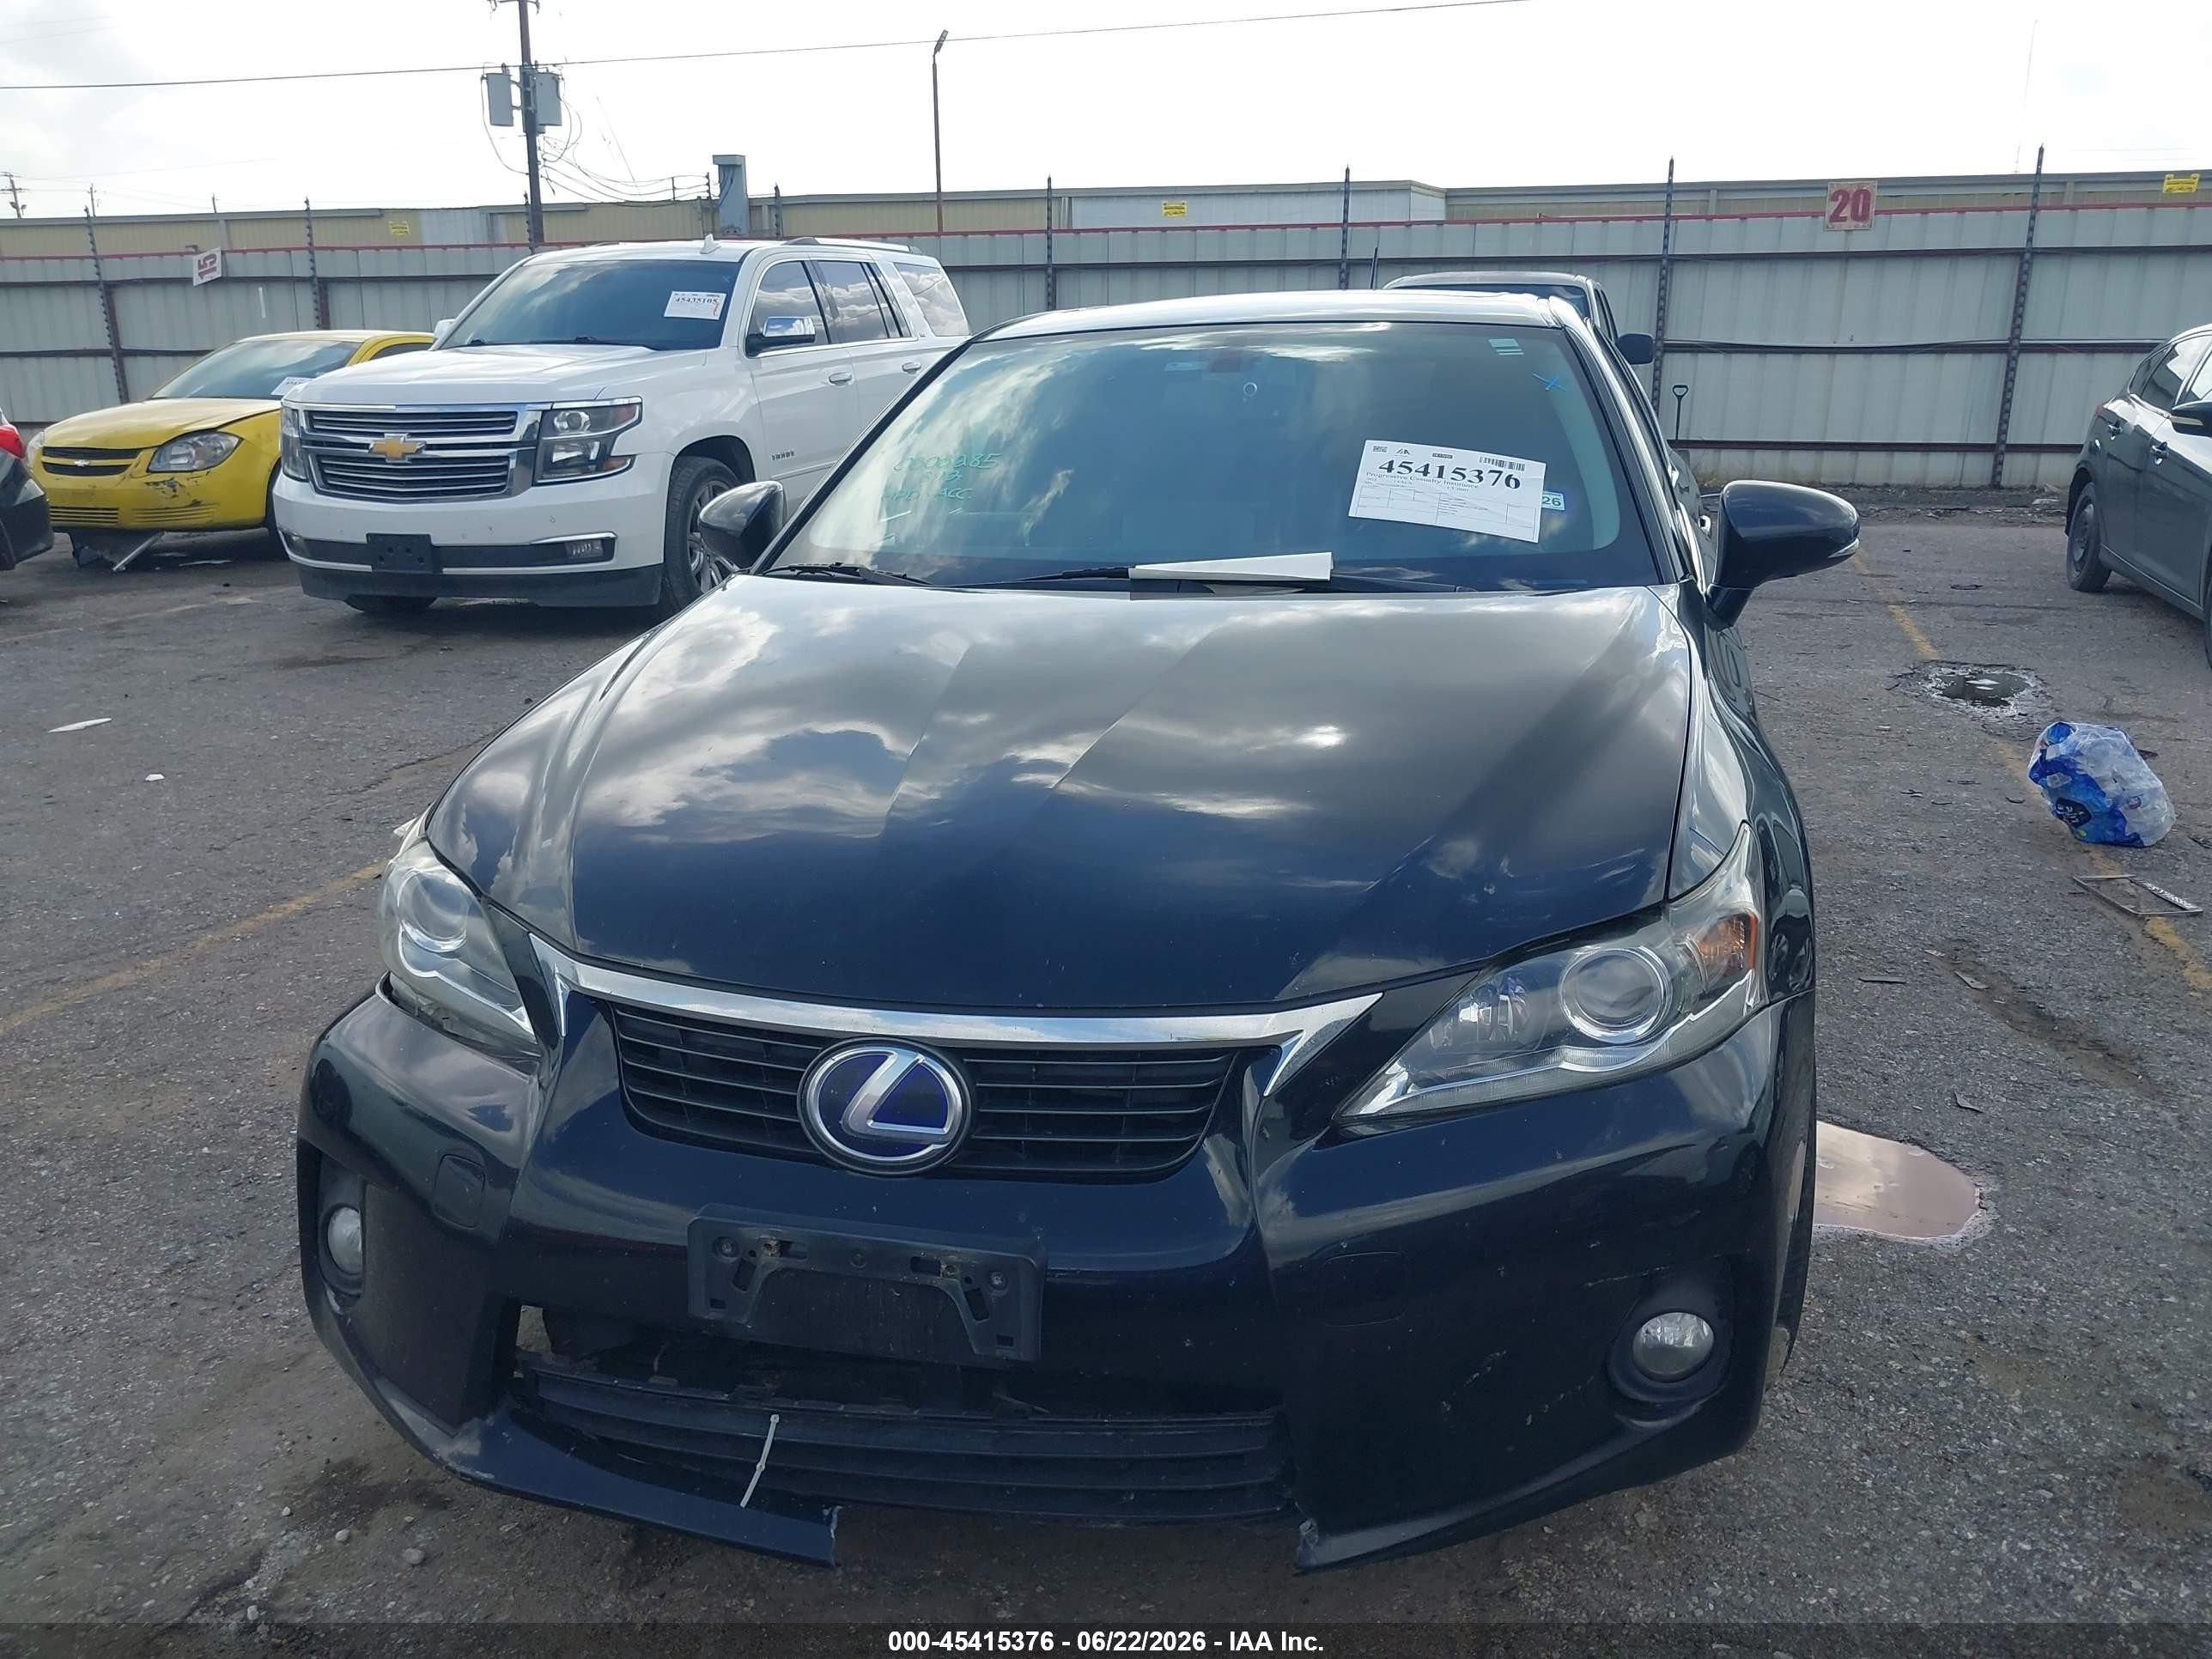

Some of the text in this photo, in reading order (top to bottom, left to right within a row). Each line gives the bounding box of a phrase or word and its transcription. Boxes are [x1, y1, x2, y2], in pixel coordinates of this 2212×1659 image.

[1829, 189, 1870, 222] 20
[198, 253, 217, 279] 15
[1366, 471, 1408, 481] Progressive
[1378, 459, 1521, 489] 45415376
[1542, 495, 1562, 507] 26
